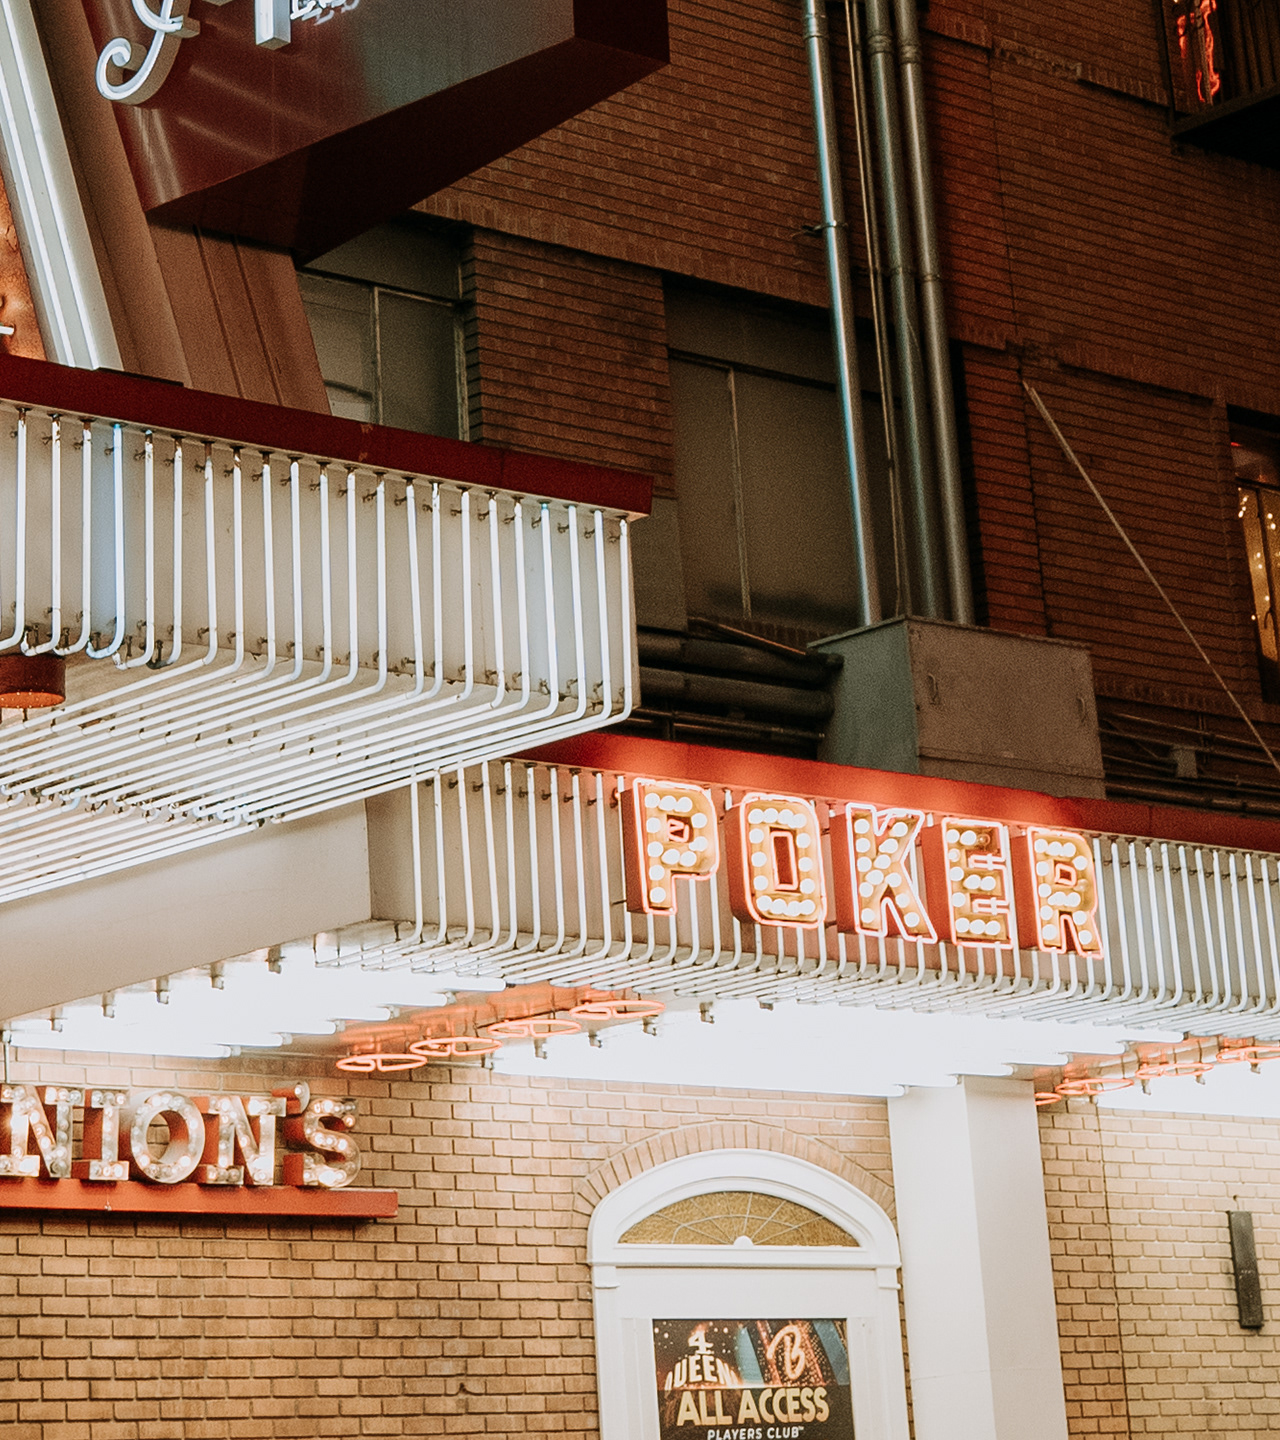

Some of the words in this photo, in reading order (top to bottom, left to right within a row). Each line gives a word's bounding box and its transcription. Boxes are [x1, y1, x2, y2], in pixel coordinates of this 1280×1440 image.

[625, 778, 1105, 960] POKER
[688, 1329, 714, 1356] 4
[676, 1389, 733, 1427] ALL
[737, 1386, 830, 1424] ACCESS
